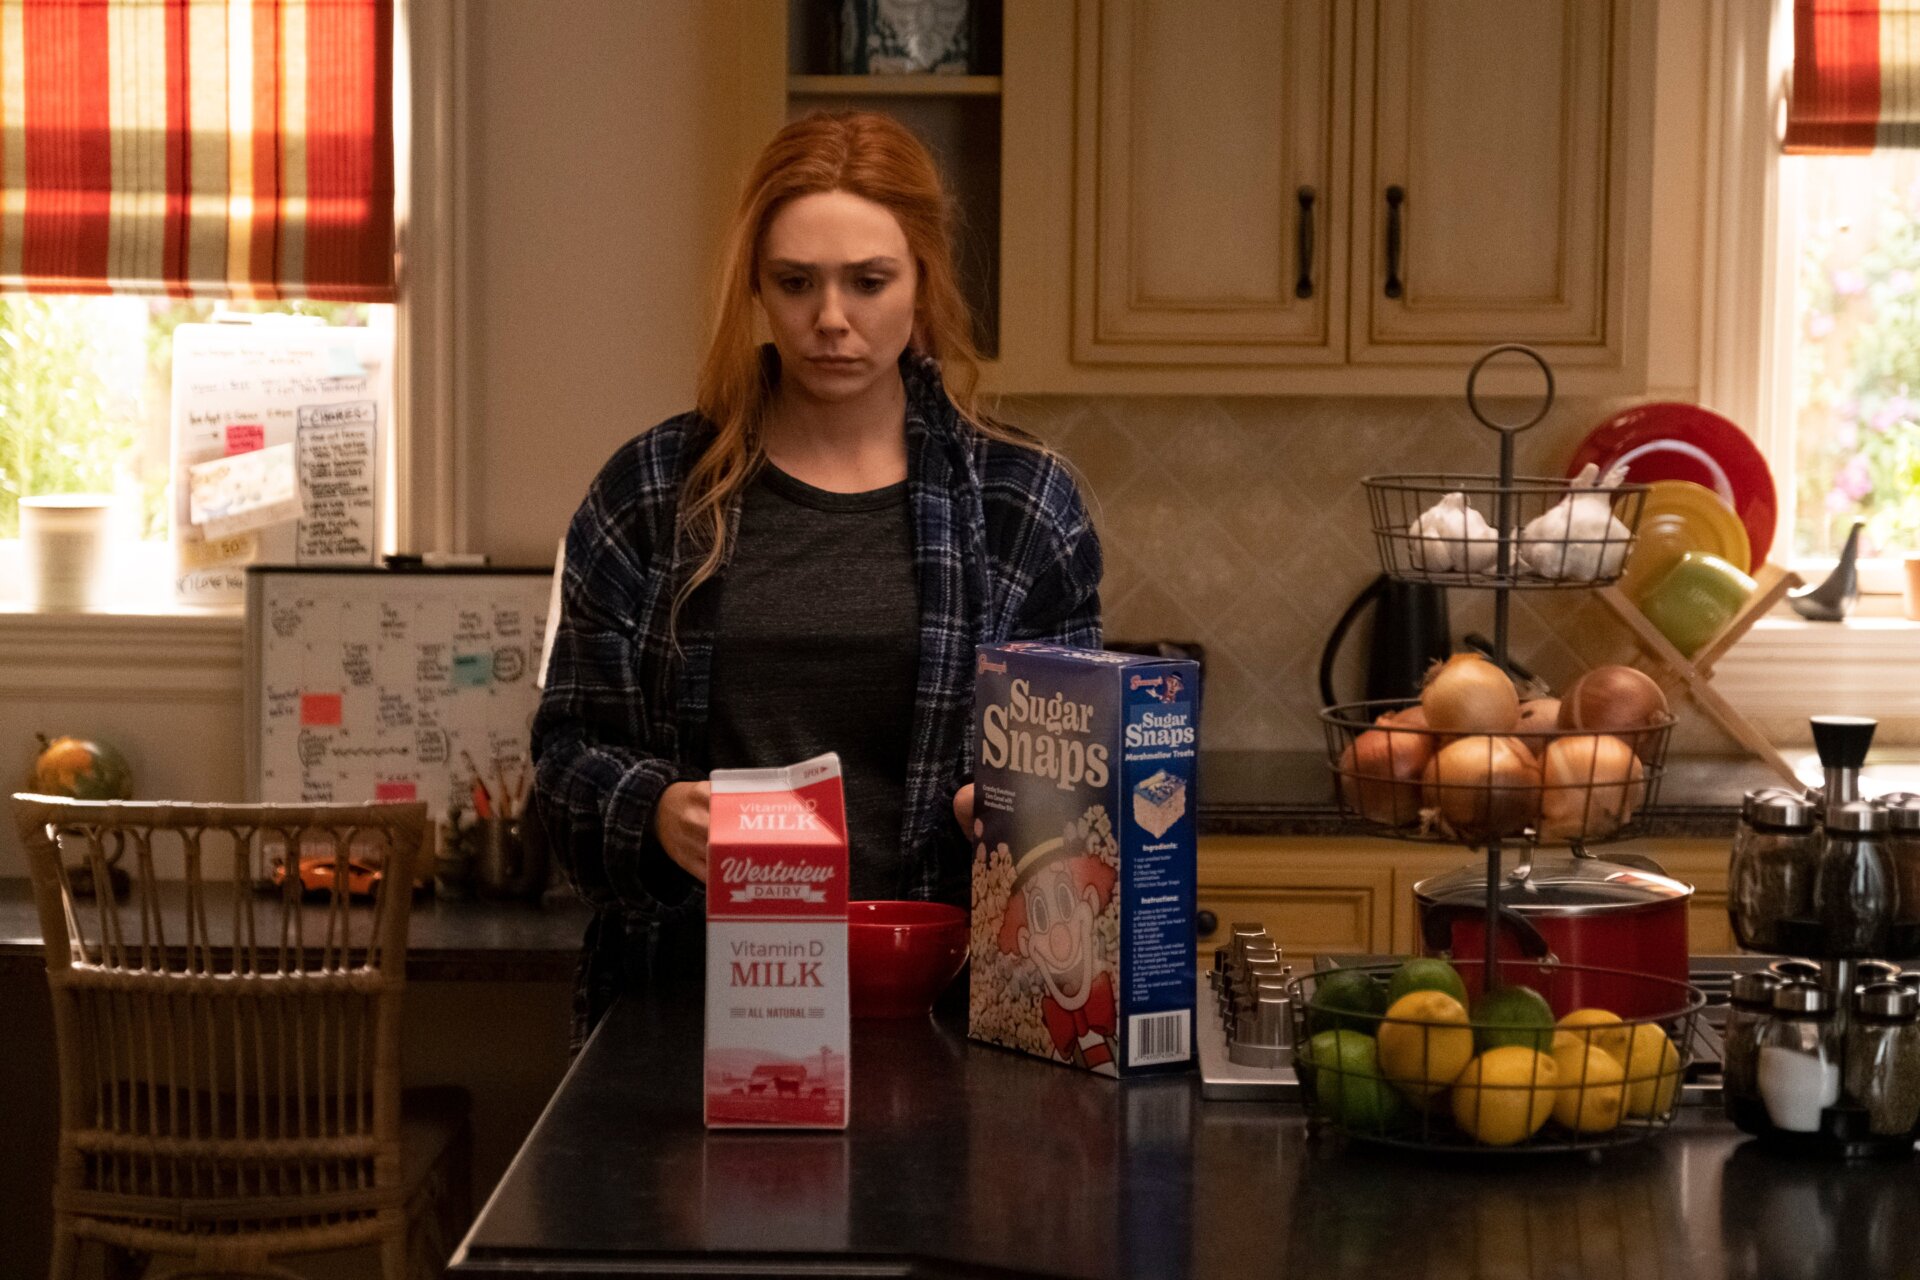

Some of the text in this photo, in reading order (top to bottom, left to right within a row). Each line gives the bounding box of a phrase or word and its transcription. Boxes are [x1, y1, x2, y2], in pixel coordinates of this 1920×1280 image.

[1010, 679, 1094, 735] Sugar
[1142, 712, 1188, 729] Sugar
[1124, 723, 1195, 748] Snaps
[982, 704, 1109, 792] Snaps
[1125, 749, 1195, 762] Marshmallow Treats
[739, 802, 802, 813] Vitamin
[738, 814, 818, 830] MILK
[720, 857, 835, 883] Westview
[754, 886, 801, 897] DAIRY
[731, 941, 824, 957] Vitamin D
[730, 961, 824, 987] MILK
[747, 1008, 806, 1018] ALL NATURAL
